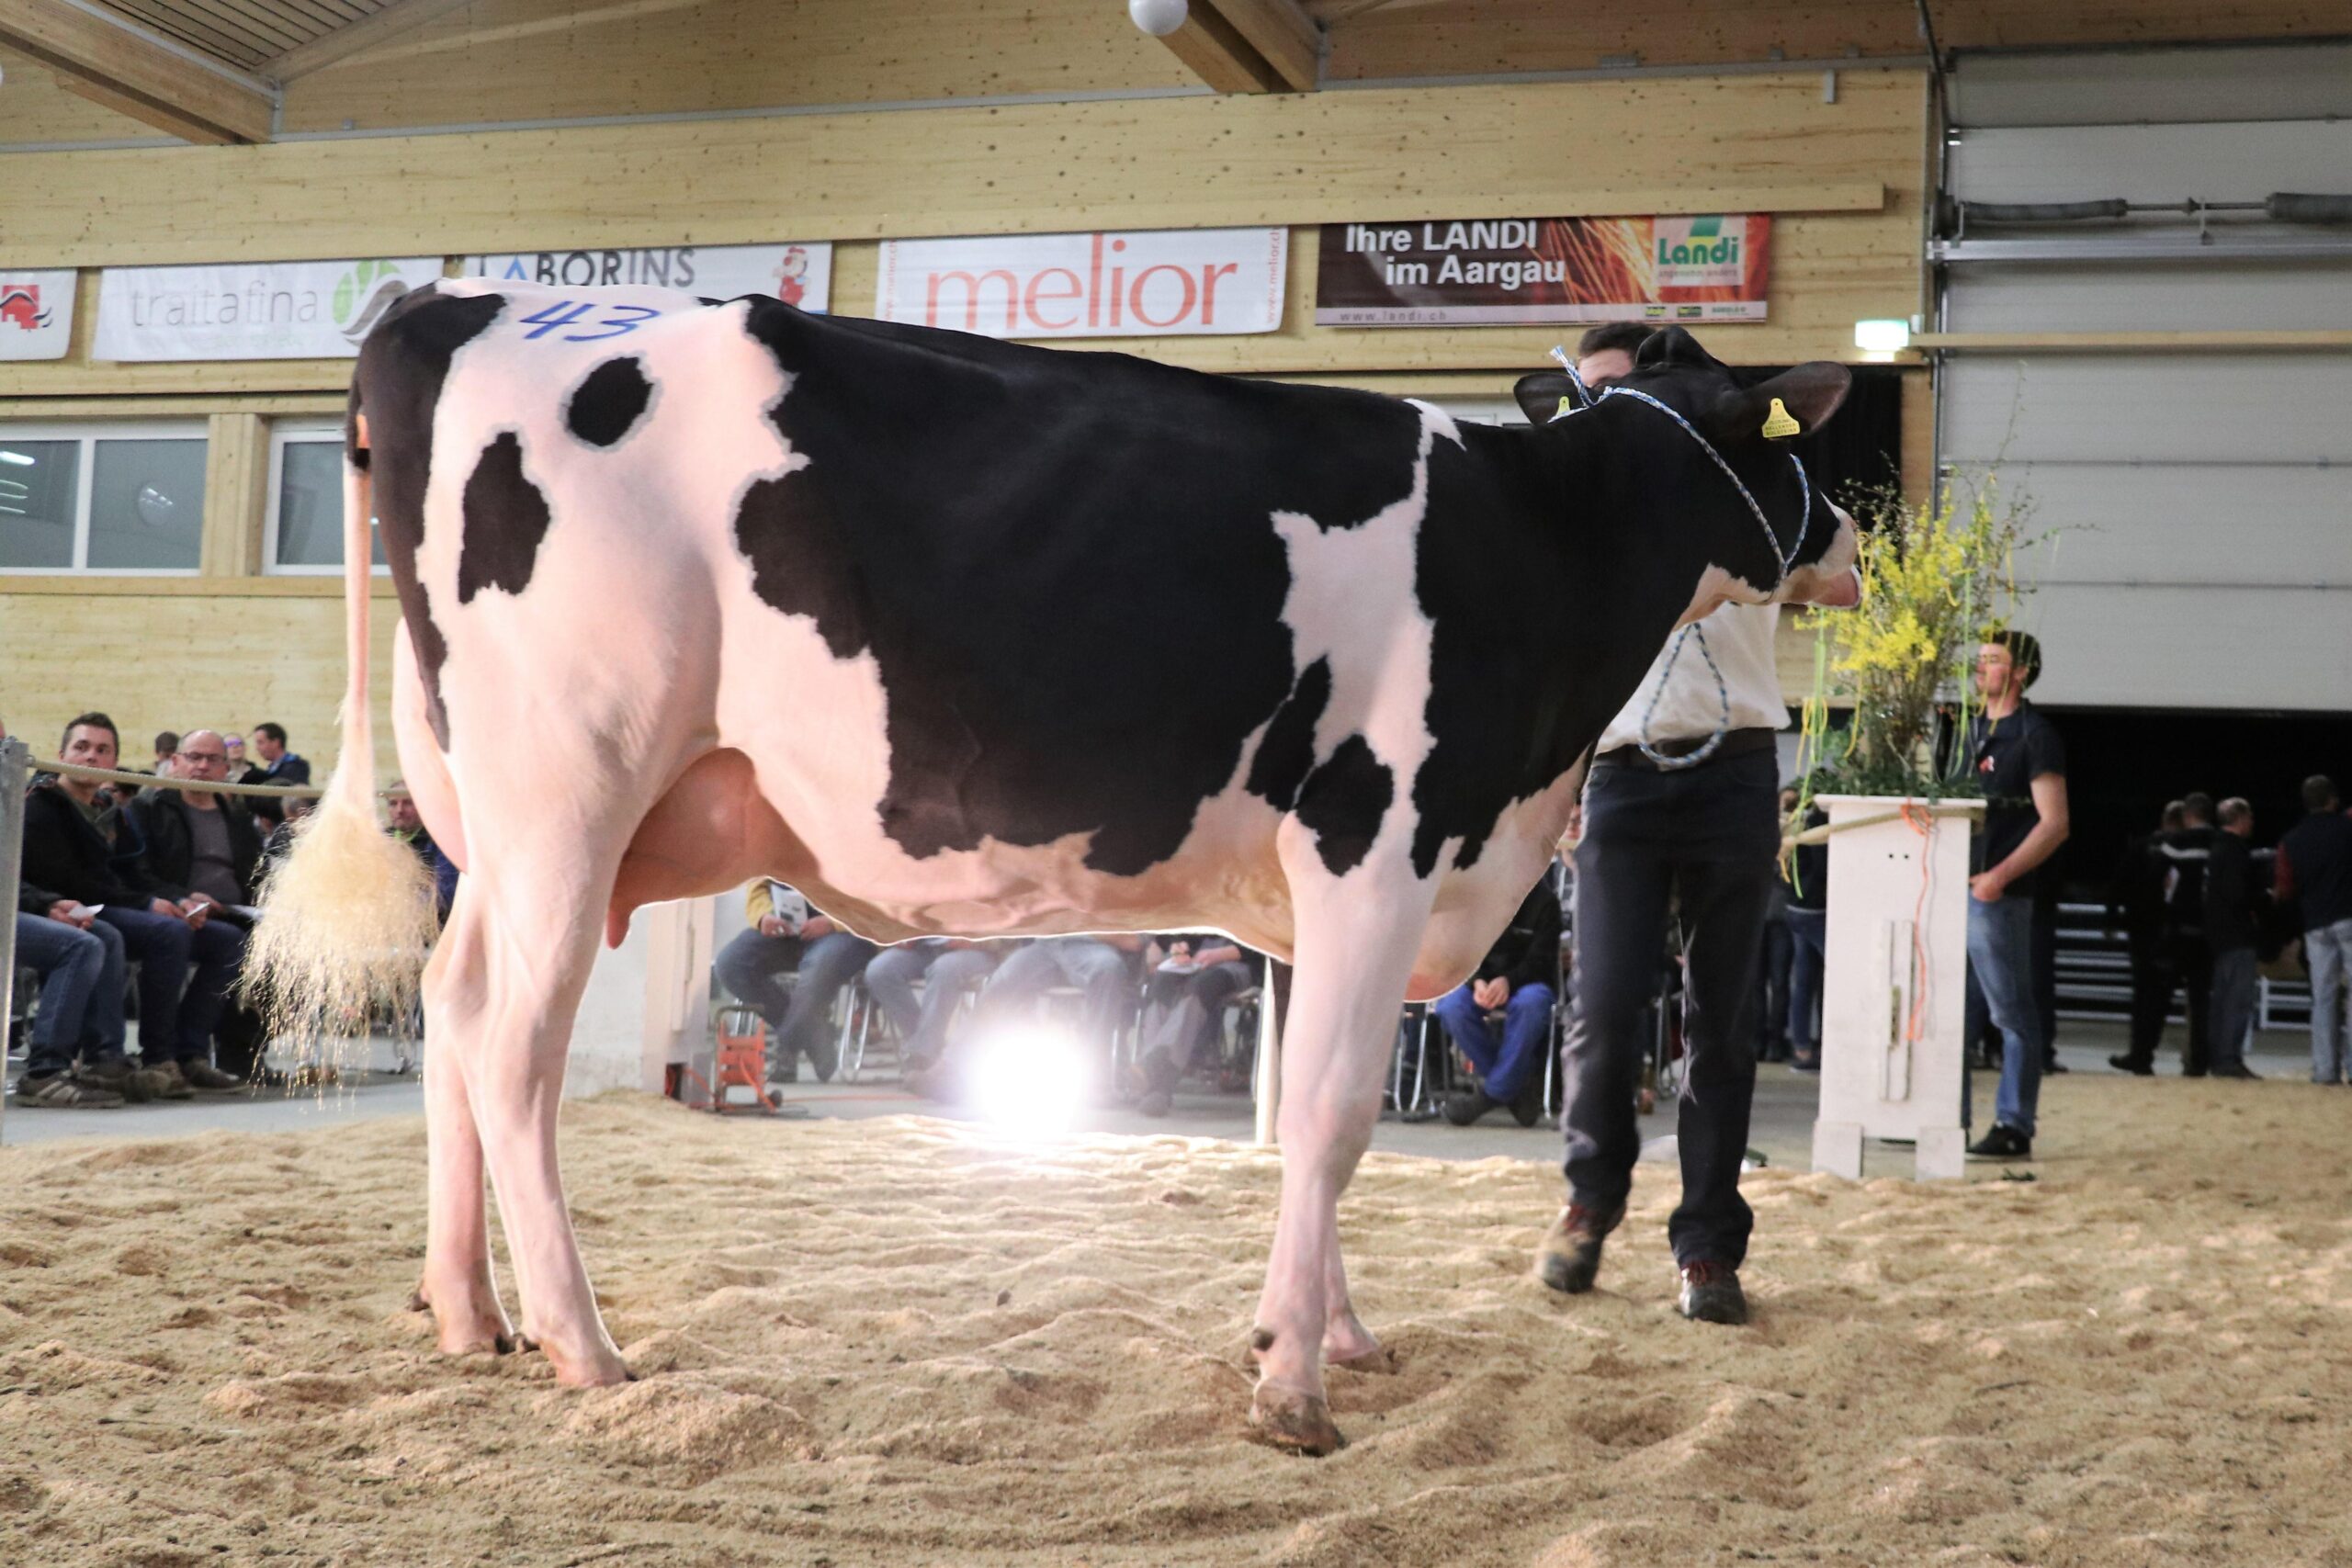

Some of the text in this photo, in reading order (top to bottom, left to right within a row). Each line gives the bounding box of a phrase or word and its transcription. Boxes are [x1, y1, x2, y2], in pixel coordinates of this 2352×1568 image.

[1346, 220, 1537, 253] Ihre LANDI
[1658, 235, 1739, 265] Landi
[925, 231, 1238, 330] melior
[1385, 254, 1566, 291] im Aargau
[131, 279, 318, 327] traitafina
[519, 300, 662, 342] 43
[1340, 310, 1447, 322] www.landi.ch
